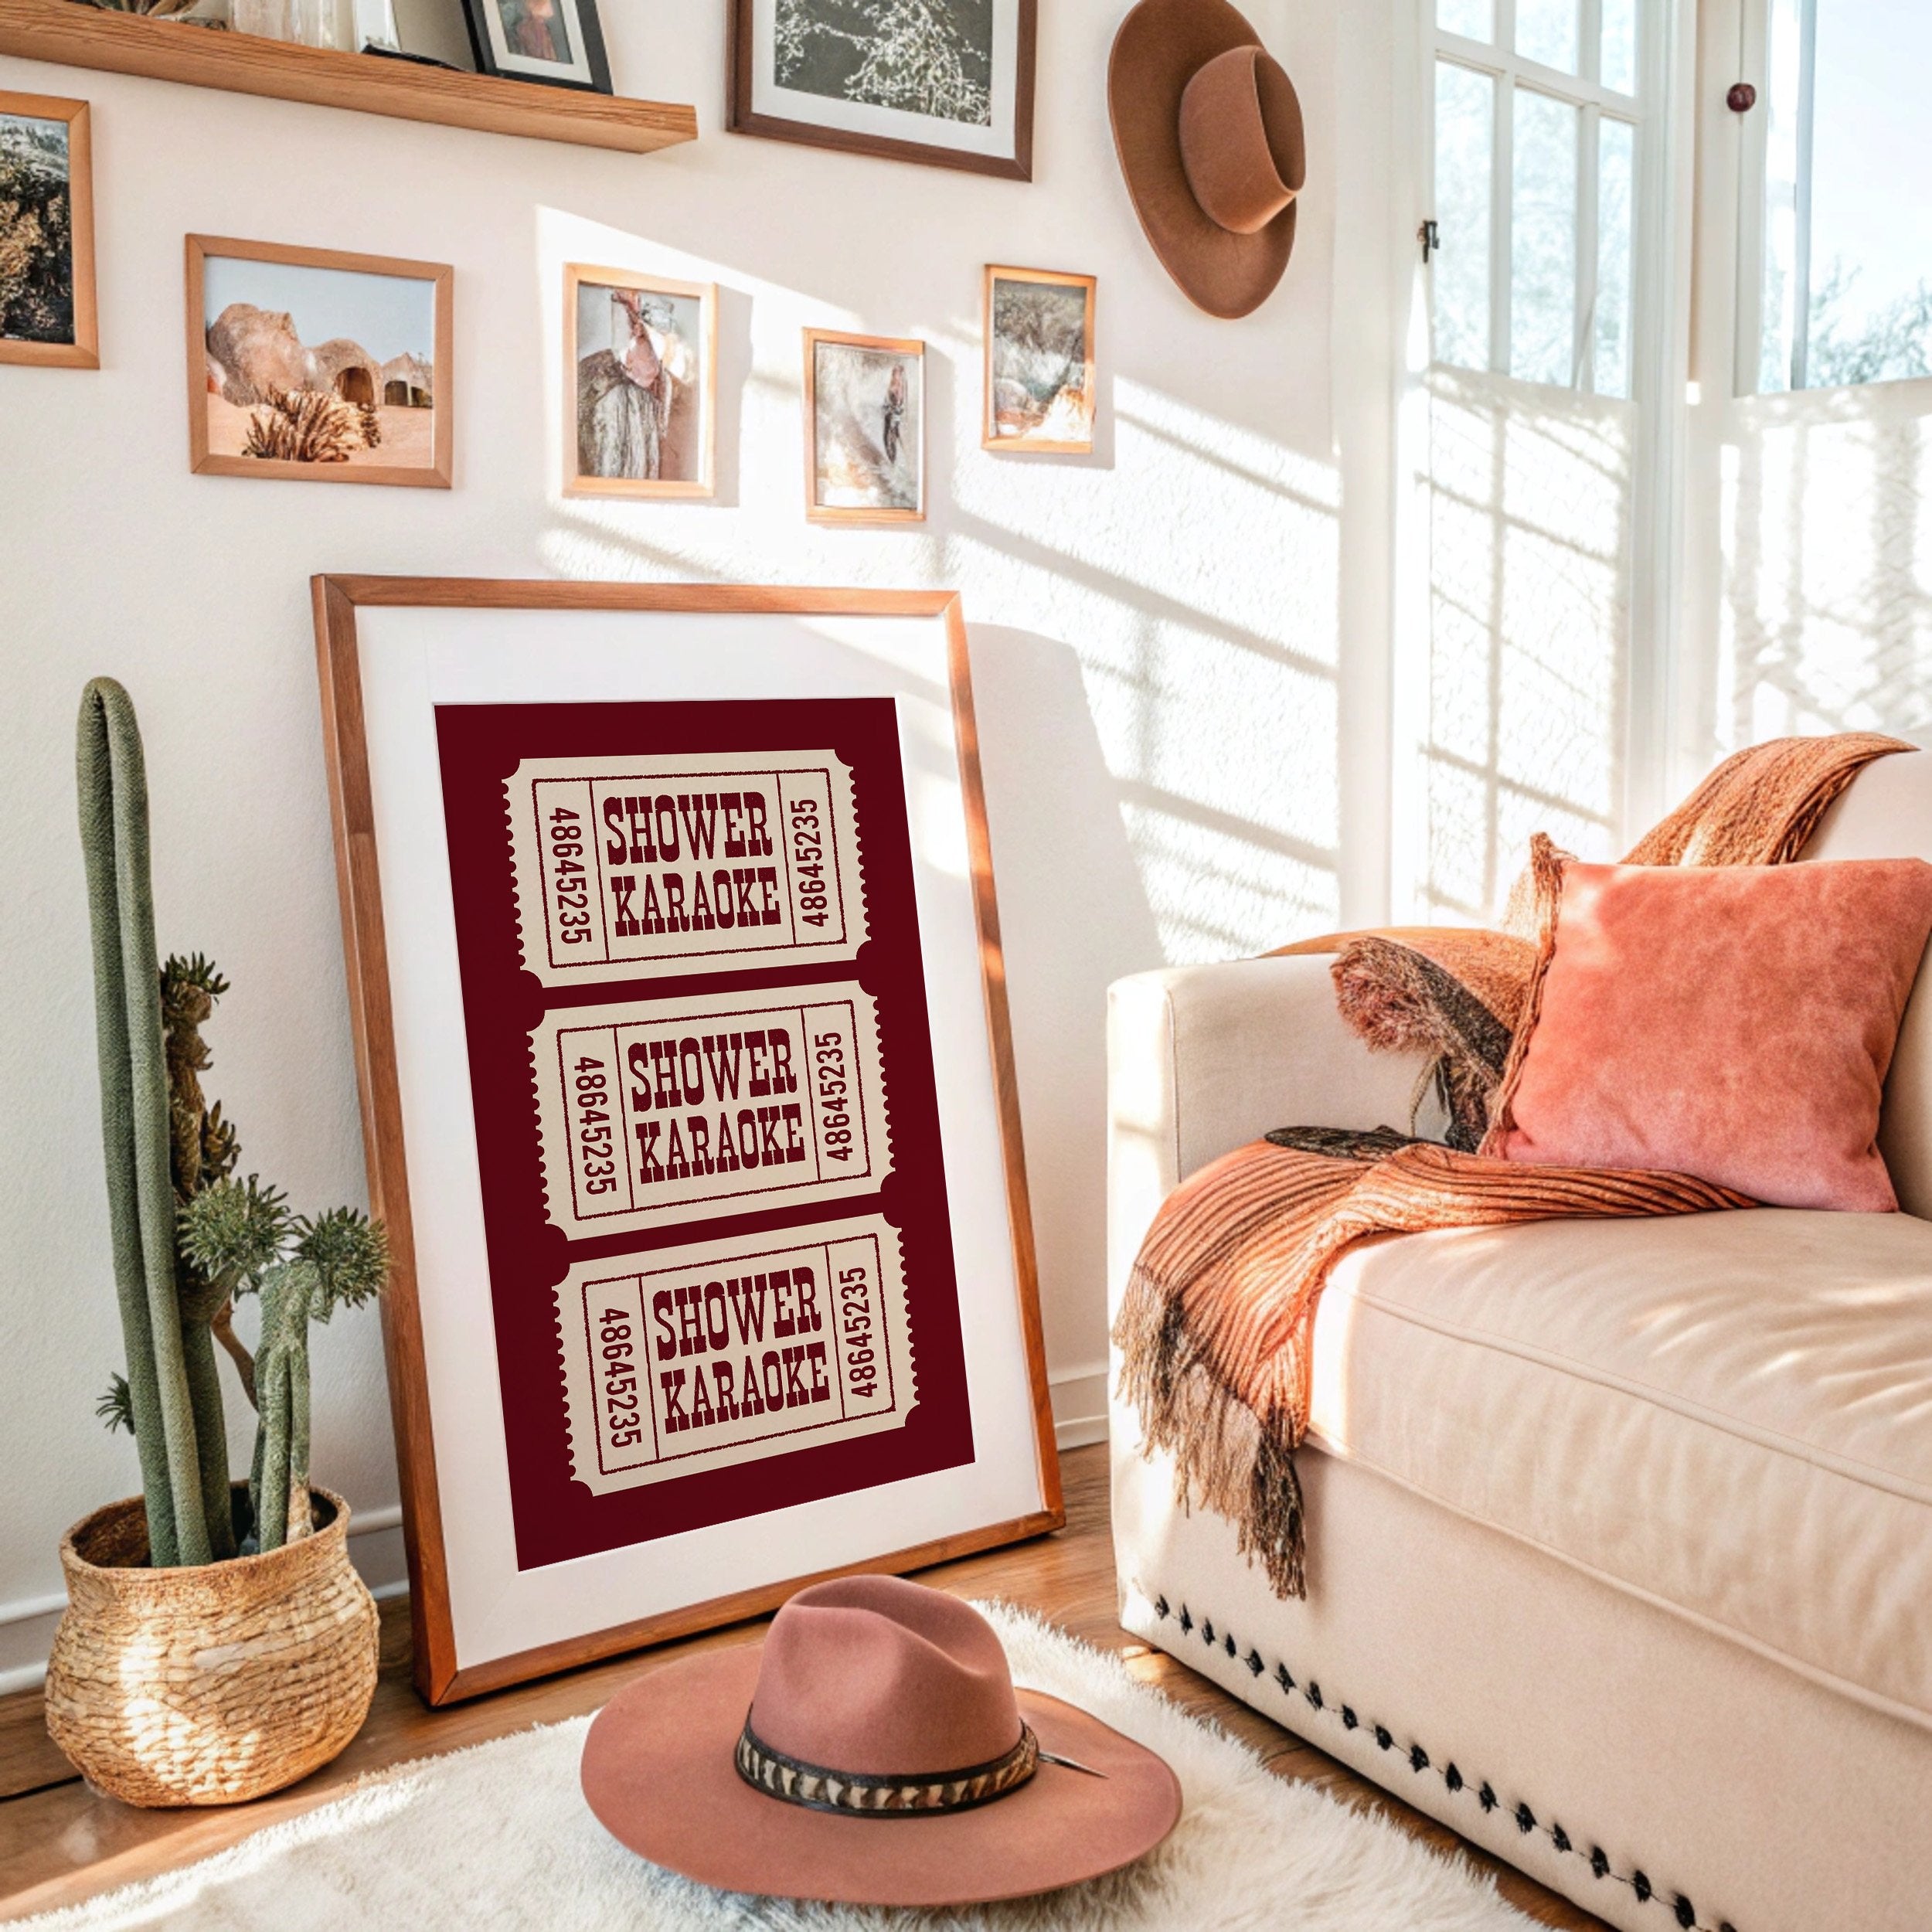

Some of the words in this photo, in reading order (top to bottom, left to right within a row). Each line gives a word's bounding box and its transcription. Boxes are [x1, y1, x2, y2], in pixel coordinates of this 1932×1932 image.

[549, 807, 593, 944] 48645235
[603, 791, 774, 866] SHOWER
[790, 799, 829, 927] 48645235
[610, 866, 781, 937] KARAOKE
[573, 1056, 617, 1196] 48645235
[628, 1028, 798, 1113] SHOWER
[814, 1032, 853, 1162] 48645235
[634, 1102, 806, 1185] KARAOKE
[652, 1266, 822, 1362] SHOWER
[838, 1267, 878, 1398] 48645235
[599, 1308, 642, 1448] 48645235
[659, 1341, 831, 1435] KARAOKE
